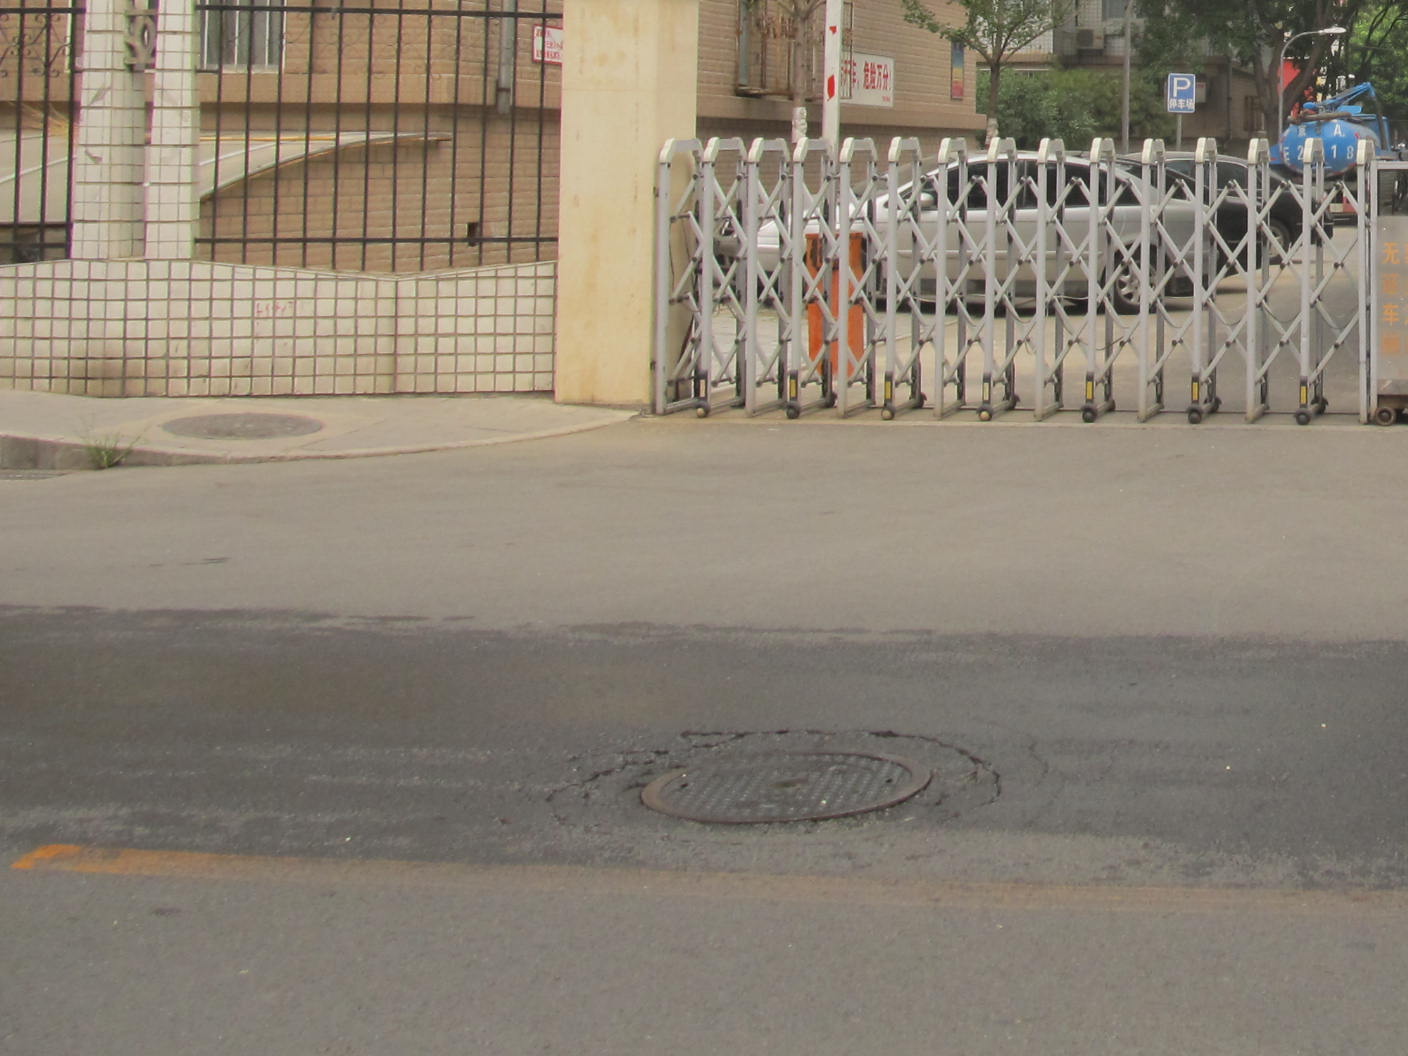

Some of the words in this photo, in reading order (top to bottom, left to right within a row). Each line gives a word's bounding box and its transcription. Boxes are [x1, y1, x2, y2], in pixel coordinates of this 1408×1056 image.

[1173, 77, 1191, 97] P
[1169, 98, 1194, 110] 停车场
[1283, 144, 1354, 161] E218
